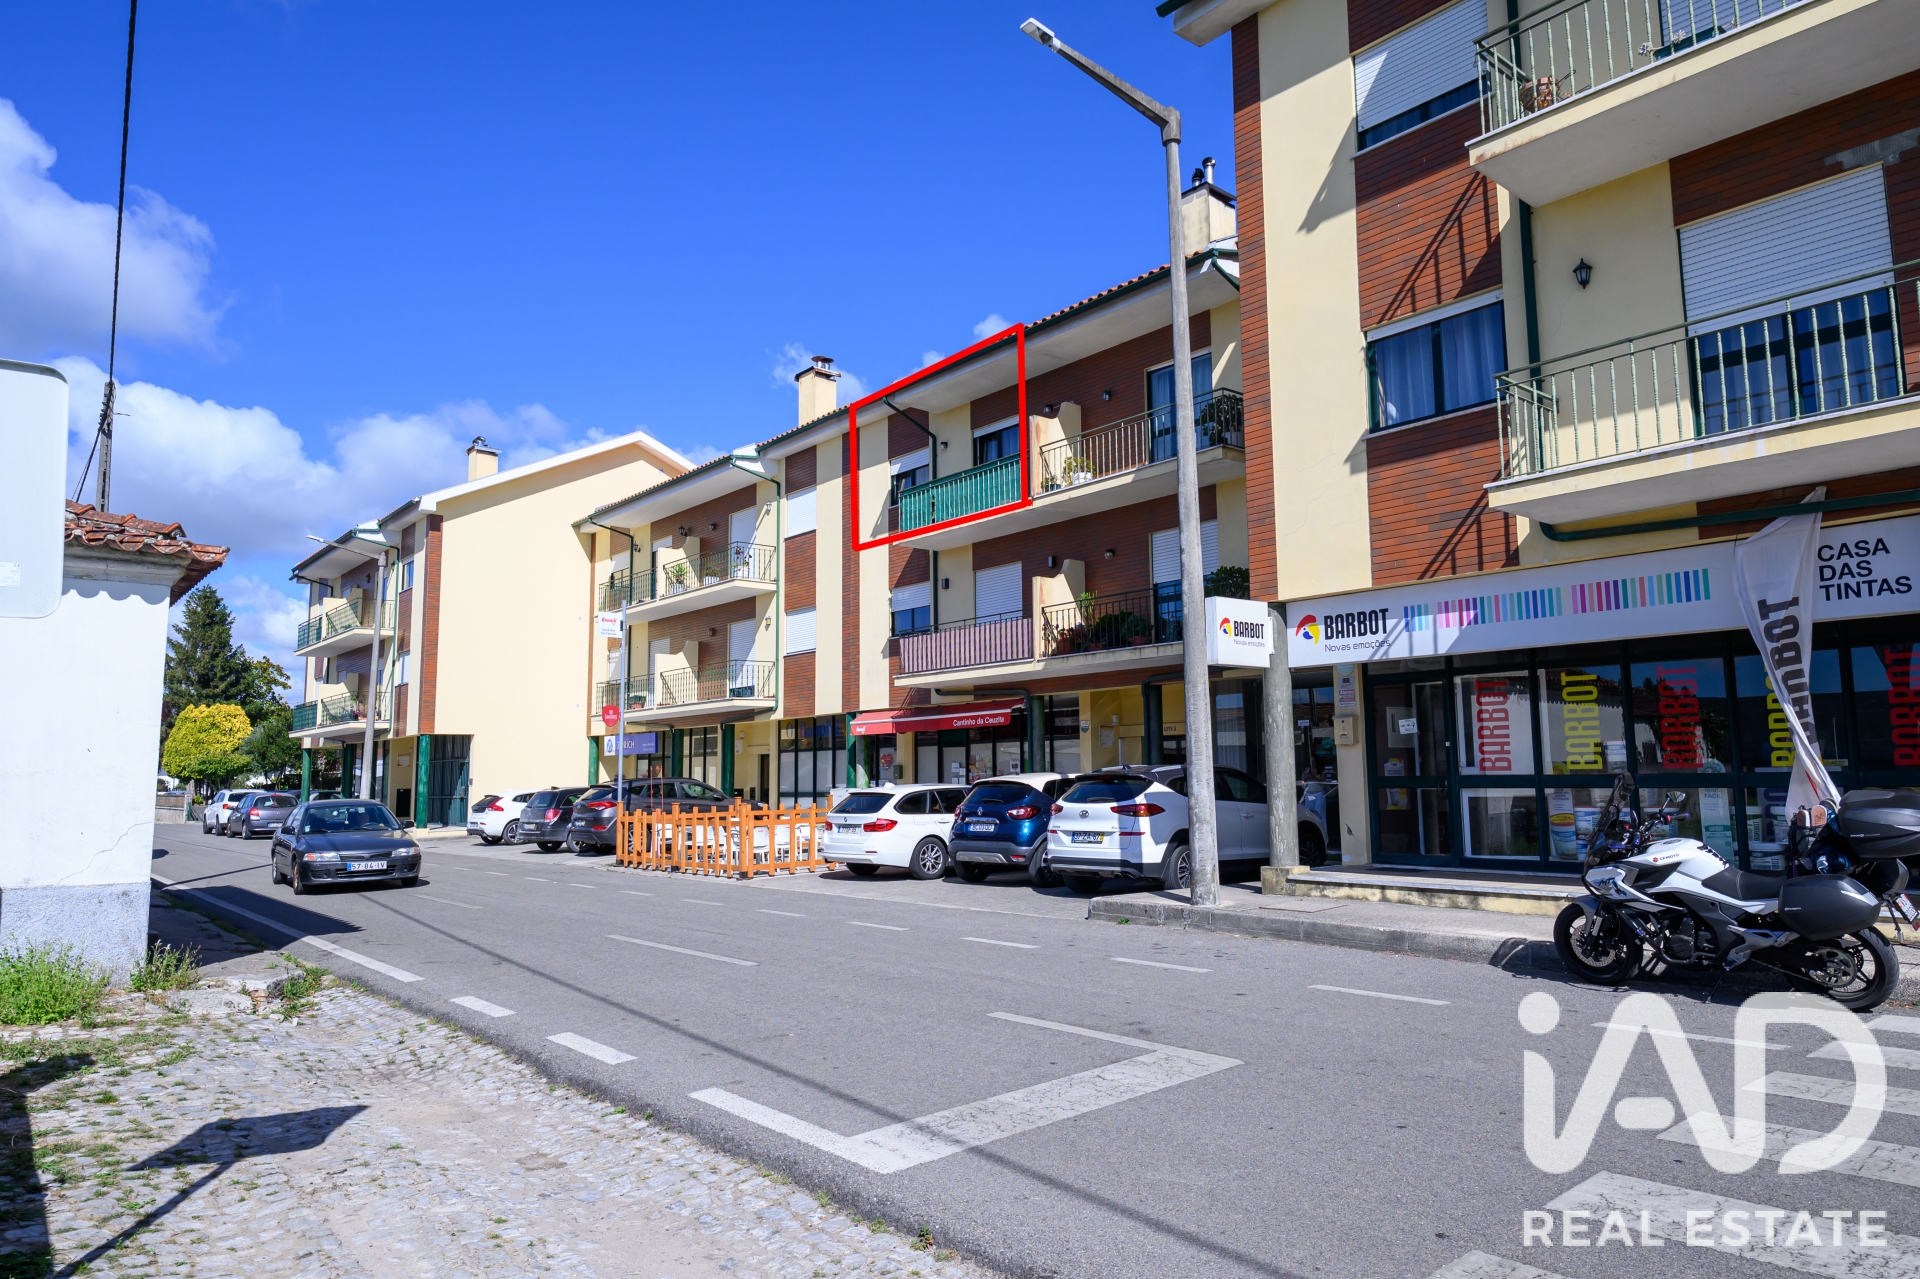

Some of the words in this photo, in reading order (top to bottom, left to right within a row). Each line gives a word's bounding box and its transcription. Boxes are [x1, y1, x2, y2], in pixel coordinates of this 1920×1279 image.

[1817, 537, 1891, 562] CASA
[1818, 559, 1873, 582] DAS
[1819, 575, 1912, 601] TINTAS
[1233, 620, 1265, 640] BARBOT
[1323, 607, 1389, 640] BARBOT
[1324, 643, 1351, 652] Novas
[1353, 639, 1391, 650] emoções
[952, 718, 976, 727] Cantinho
[976, 717, 984, 725] da
[1475, 678, 1513, 772] BARBOT
[1560, 672, 1604, 771] BARBOT
[1656, 665, 1704, 769] BARBOT
[616, 740, 635, 750] ZRICH
